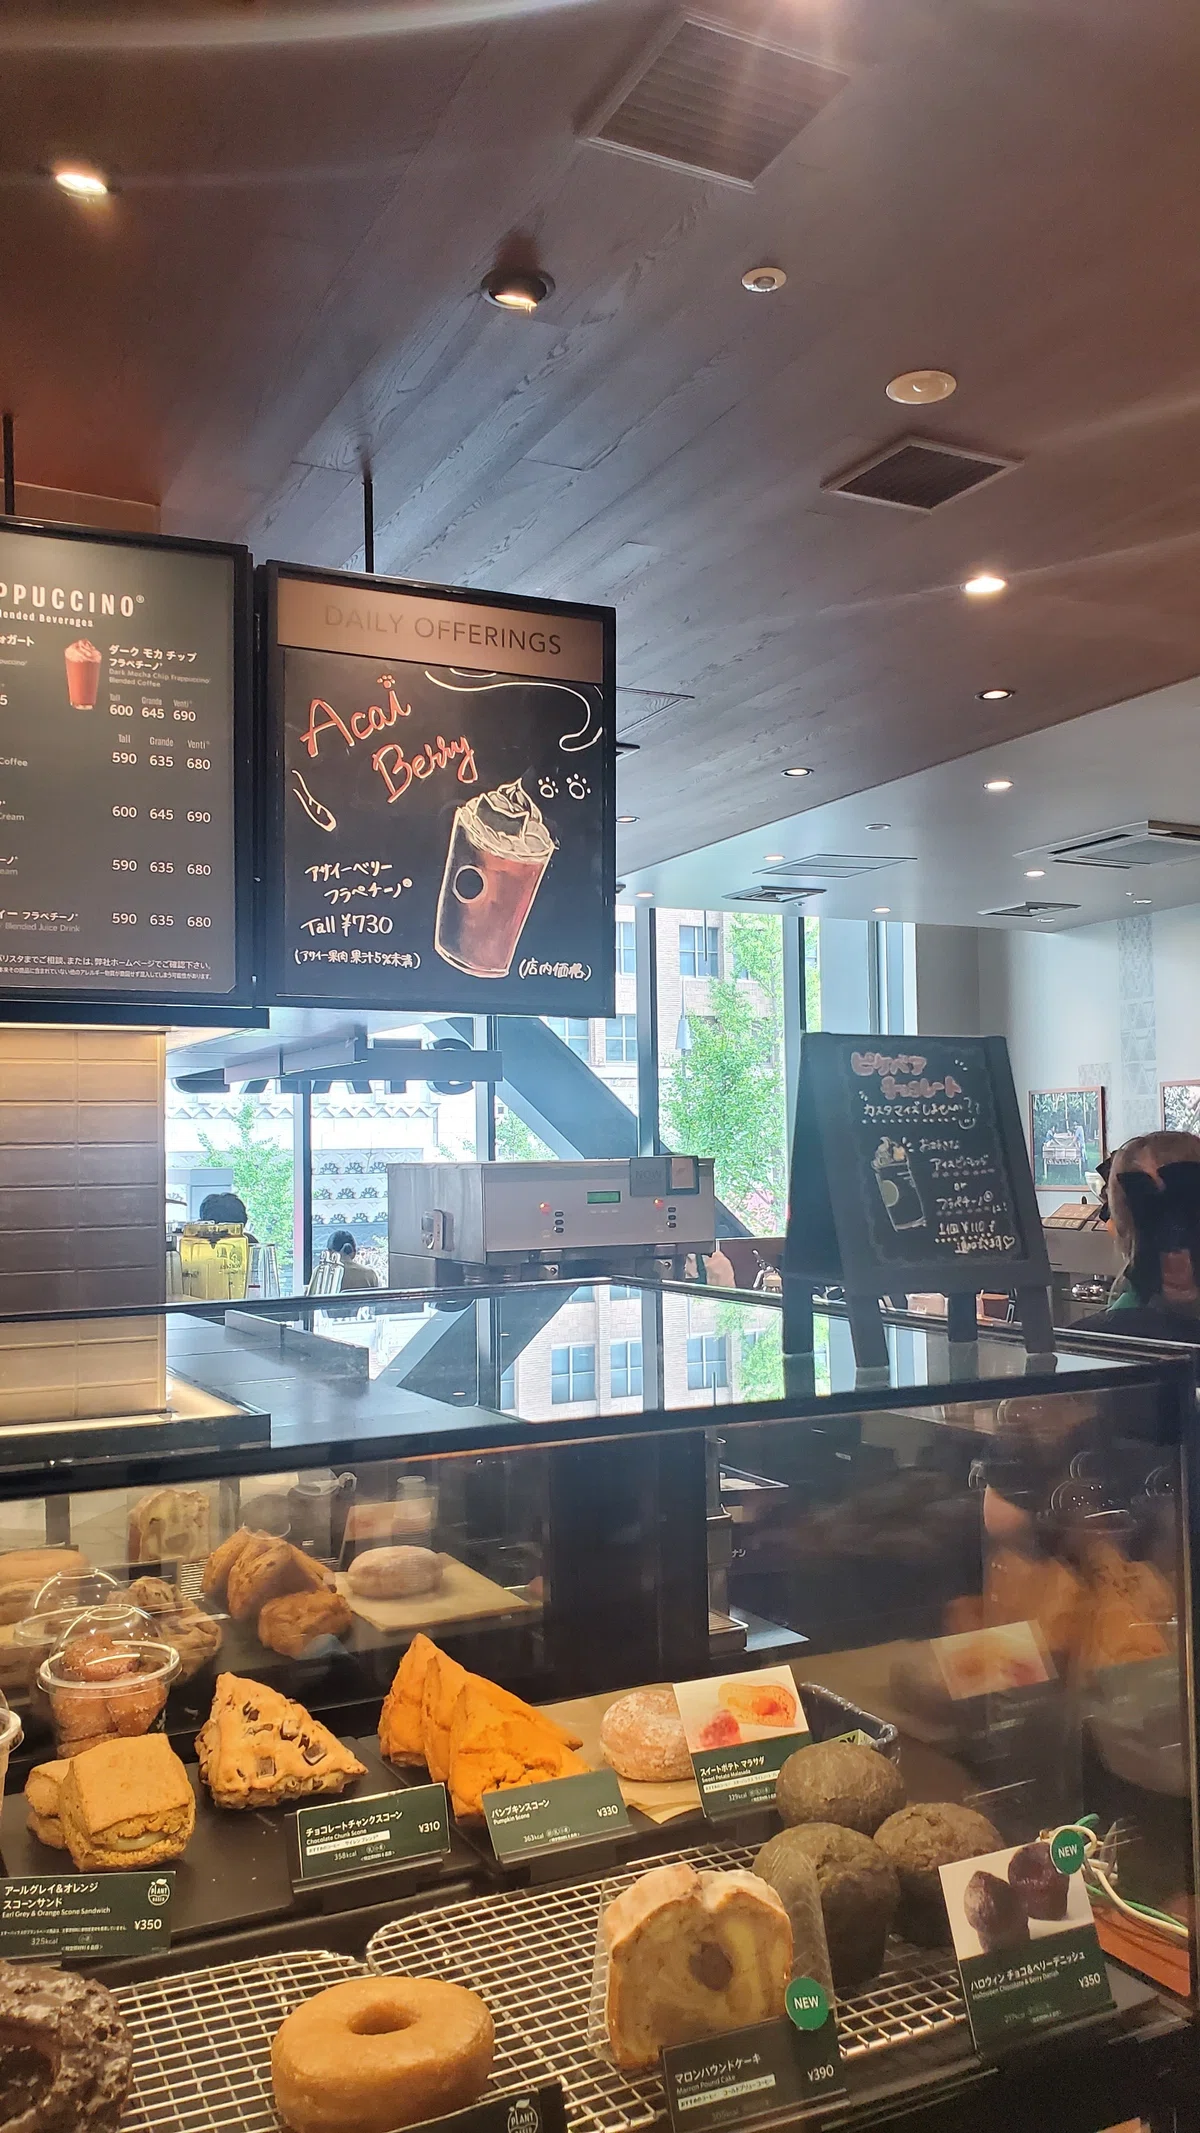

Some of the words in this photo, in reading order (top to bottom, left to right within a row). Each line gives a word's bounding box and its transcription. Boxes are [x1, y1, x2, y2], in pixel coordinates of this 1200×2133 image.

[39, 613, 93, 627] Beverages
[324, 604, 404, 634] DAILY
[414, 617, 562, 655] OFFERINGS
[109, 644, 139, 657] ダーク
[143, 648, 163, 660] モカ
[166, 650, 197, 663] チップ
[127, 670, 151, 679] Mocha
[153, 672, 170, 681] Chip
[137, 678, 161, 687] Coffee
[110, 704, 133, 716] 600
[141, 707, 165, 719] 645
[173, 710, 196, 722] 690
[118, 734, 131, 743] Tall
[149, 737, 174, 747] Grande
[112, 752, 137, 764] 590
[149, 755, 174, 767] 635
[187, 758, 211, 770] 680
[372, 735, 478, 803] Berry
[112, 806, 137, 818] 600
[149, 808, 174, 821] 645
[187, 811, 211, 823] 690
[112, 859, 137, 871] 590
[149, 861, 174, 874] 635
[187, 864, 211, 876] 680
[304, 861, 393, 882] アサイーベリー
[5, 922, 37, 931] Blended
[39, 923, 58, 932] Juice
[60, 924, 80, 932] Drink
[112, 913, 137, 925] 590
[149, 915, 174, 926] 635
[187, 916, 211, 928] 680
[300, 915, 336, 936] Tall
[341, 913, 393, 937] ¥730
[953, 1182, 968, 1192] or
[700, 1761, 740, 1777] スイートポテト
[597, 1805, 618, 1818] ¥330
[305, 1810, 403, 1837] チョコレートチャンクスコーン
[418, 1821, 441, 1834] ¥310
[306, 1836, 334, 1845] Chocolate
[334, 1832, 351, 1840] Chunk
[351, 1828, 367, 1837] Scone
[1058, 1844, 1077, 1858] NEW
[4, 1882, 98, 1896] アールグレイ&オレンジ
[151, 1885, 168, 1895] PLANT
[3, 1897, 62, 1910] スコーンサンド
[2, 1910, 15, 1918] Earl
[15, 1910, 30, 1919] Grey
[37, 1909, 60, 1918] Orange
[61, 1908, 80, 1916] Scone
[81, 1906, 111, 1915] Sandwich
[134, 1918, 162, 1931] ¥350
[30, 1937, 58, 1946] 325kcal
[970, 1972, 1004, 1991] ハロウィン
[1079, 1973, 1100, 1989] ¥350
[794, 1996, 819, 2010] NEW
[807, 2064, 834, 2082] ¥390
[676, 2084, 700, 2095] Marron
[700, 2079, 720, 2089] Pound
[721, 2074, 736, 2084] Cake
[511, 2110, 534, 2126] PLANT
